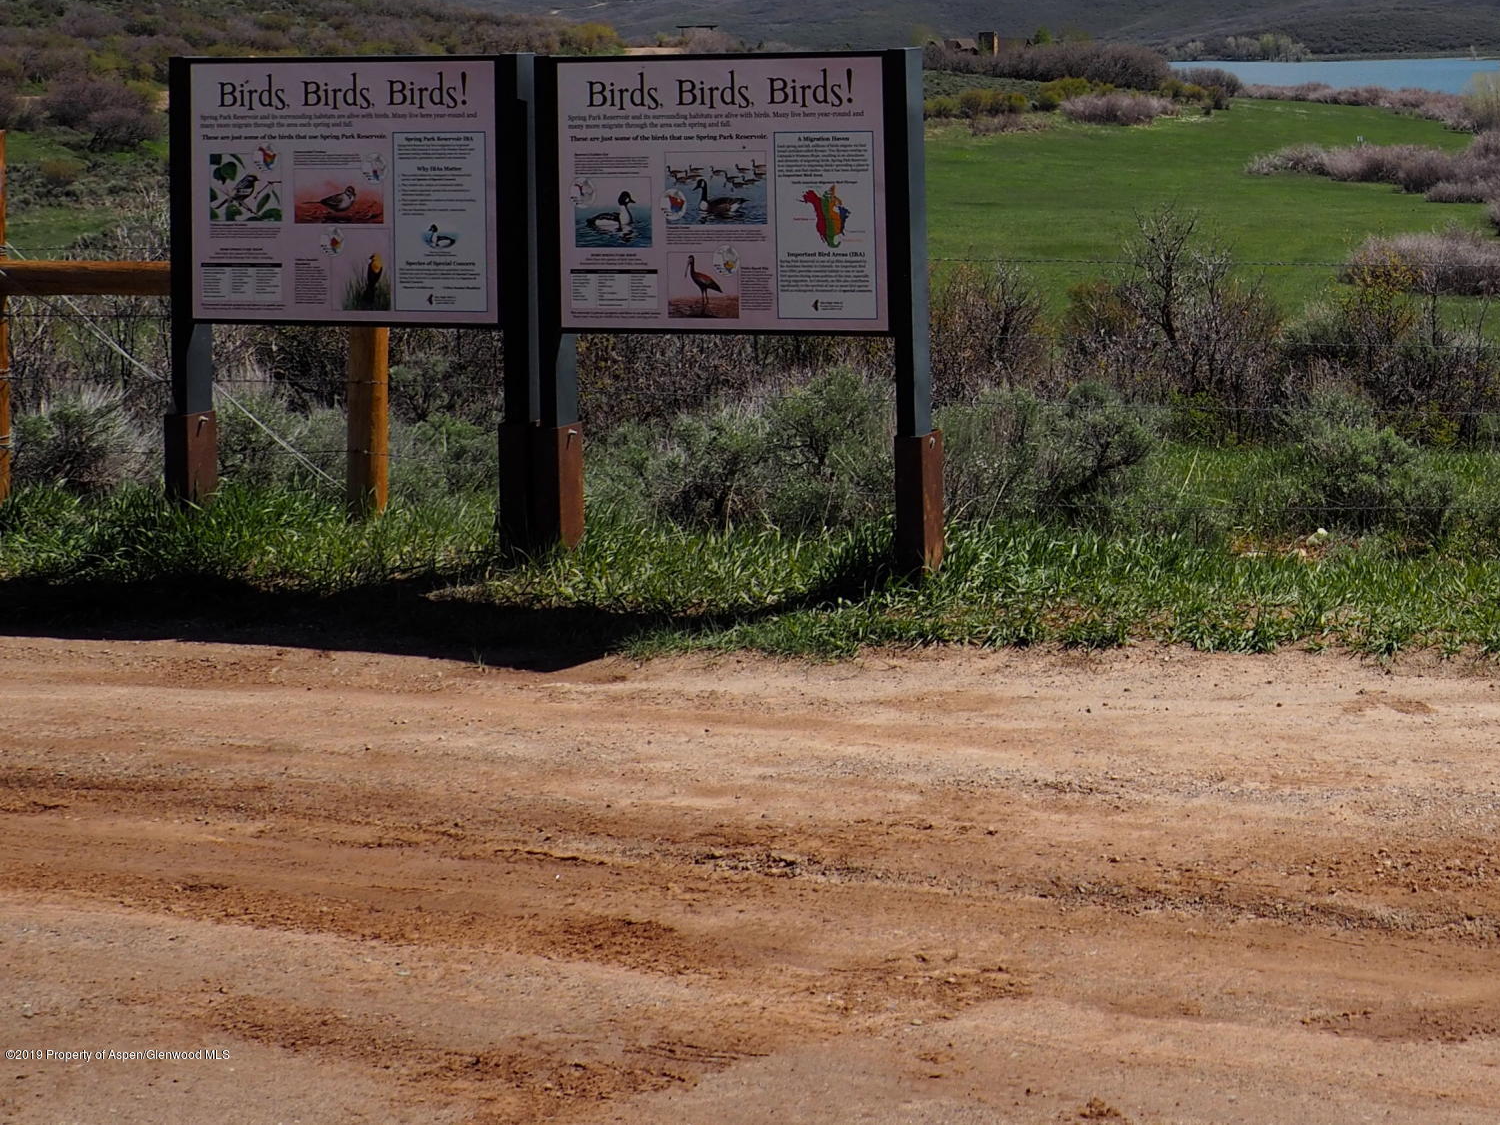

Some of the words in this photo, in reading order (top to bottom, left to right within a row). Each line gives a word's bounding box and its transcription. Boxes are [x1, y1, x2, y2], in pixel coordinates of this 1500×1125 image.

[218, 73, 290, 111] Birds,
[301, 72, 375, 110] Birds,
[386, 71, 468, 109] Birds!
[586, 71, 664, 111] Birds,
[675, 69, 755, 109] Birds,
[767, 67, 854, 108] Birds!
[688, 121, 706, 129] spring
[773, 111, 789, 119] Many
[817, 110, 851, 119] year-round
